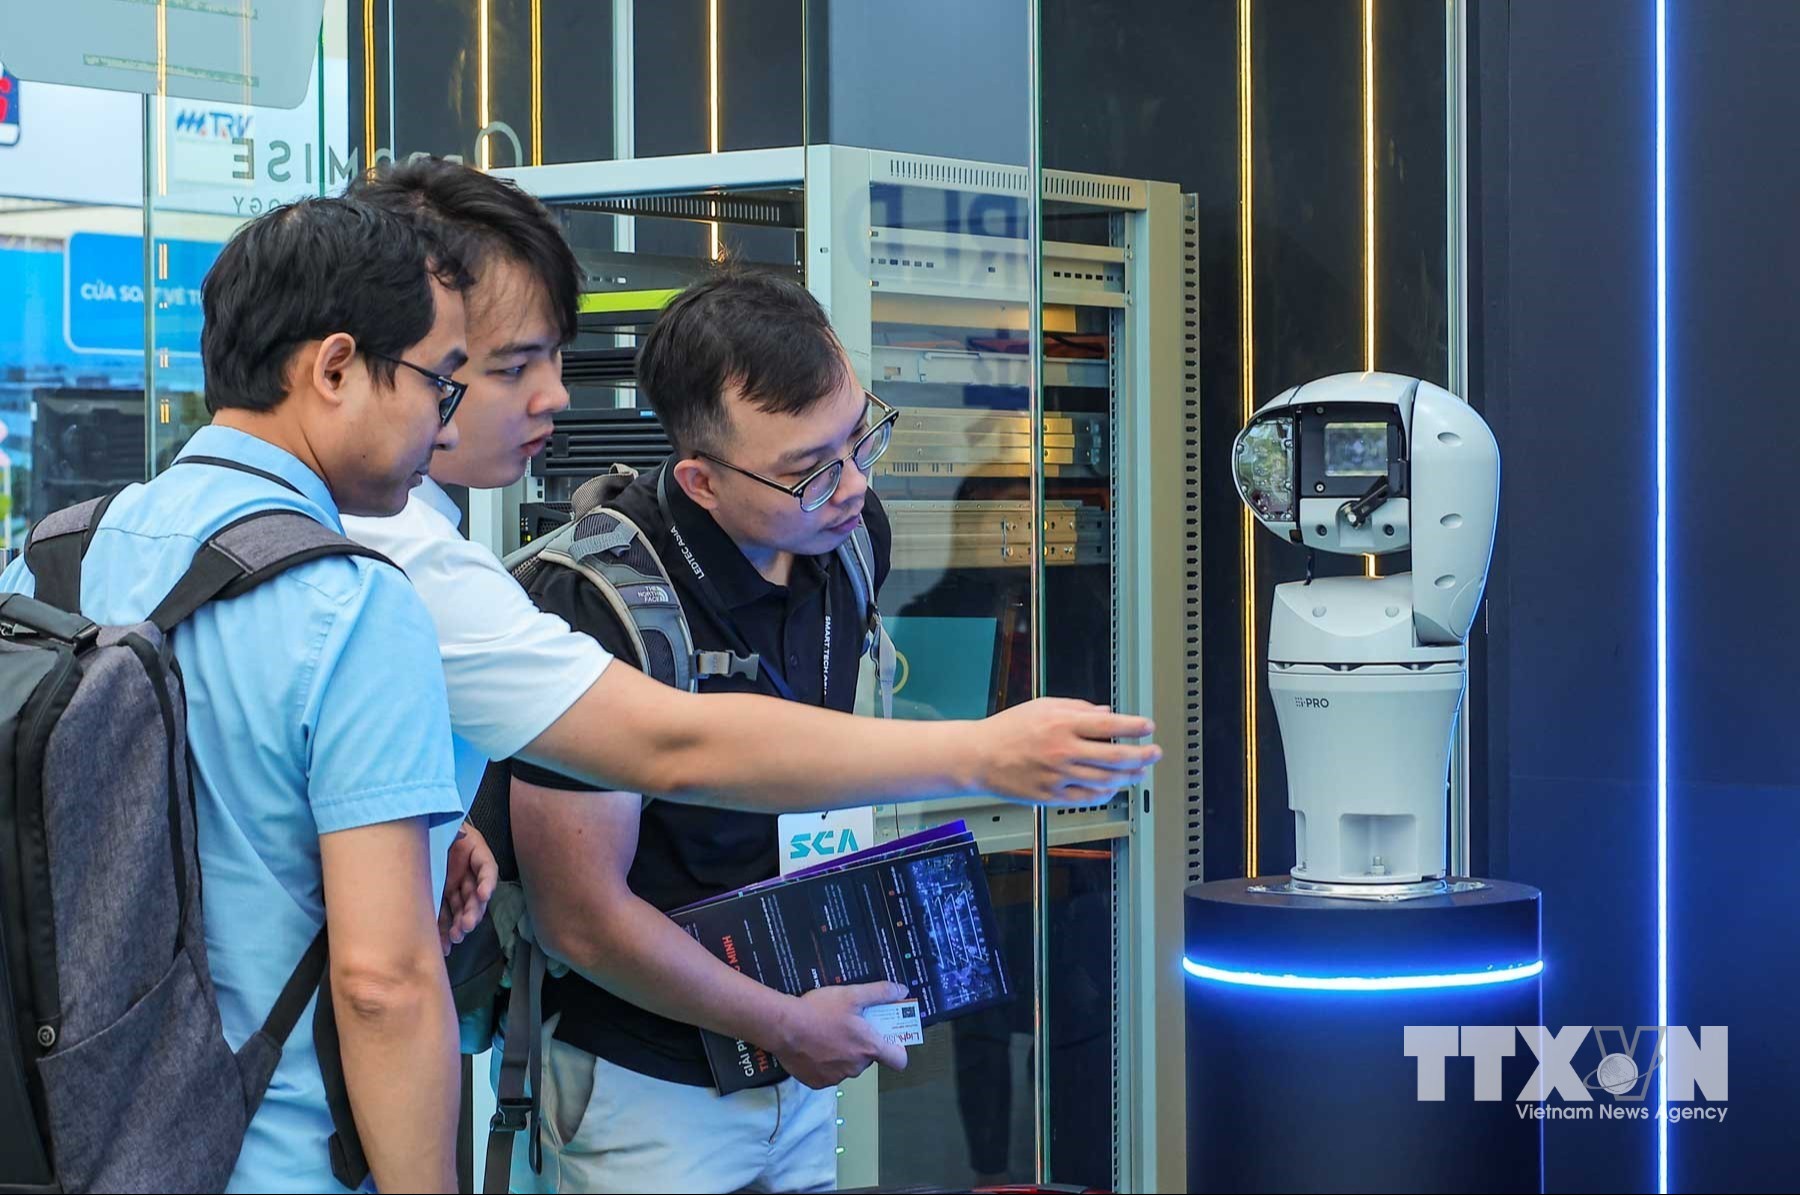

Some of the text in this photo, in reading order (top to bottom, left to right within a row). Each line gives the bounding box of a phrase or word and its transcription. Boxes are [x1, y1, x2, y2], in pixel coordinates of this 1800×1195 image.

[670, 525, 705, 580] LEDTEC ASIA
[790, 828, 860, 860] SCA
